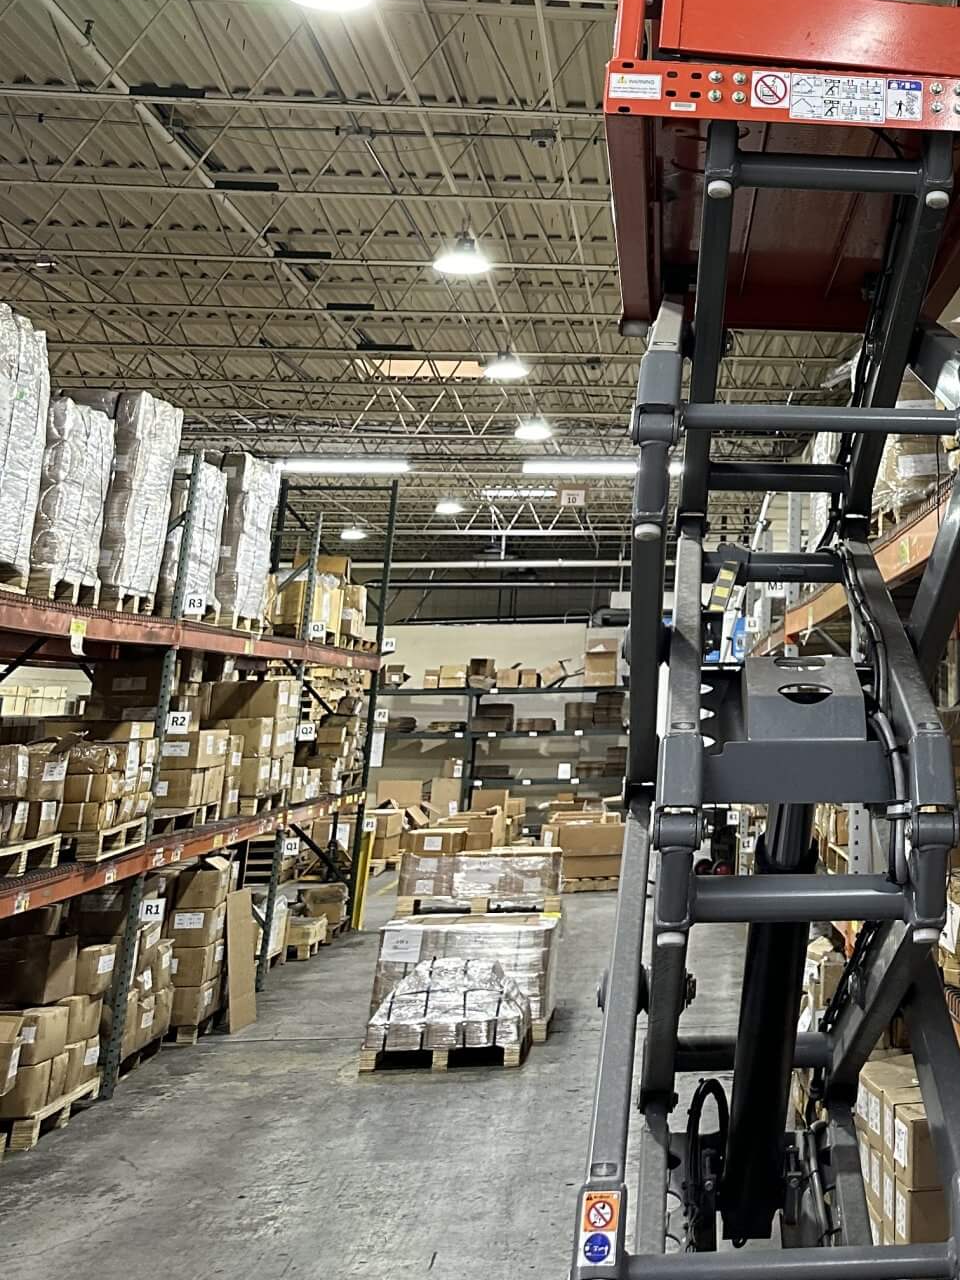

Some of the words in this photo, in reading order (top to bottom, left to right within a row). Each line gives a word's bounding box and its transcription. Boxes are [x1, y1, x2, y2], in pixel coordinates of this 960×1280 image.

[188, 596, 203, 608] R3
[312, 624, 324, 633] Q3
[171, 716, 186, 727] R2
[301, 726, 314, 736] Q2
[286, 841, 297, 851] Q1
[145, 904, 160, 915] R1
